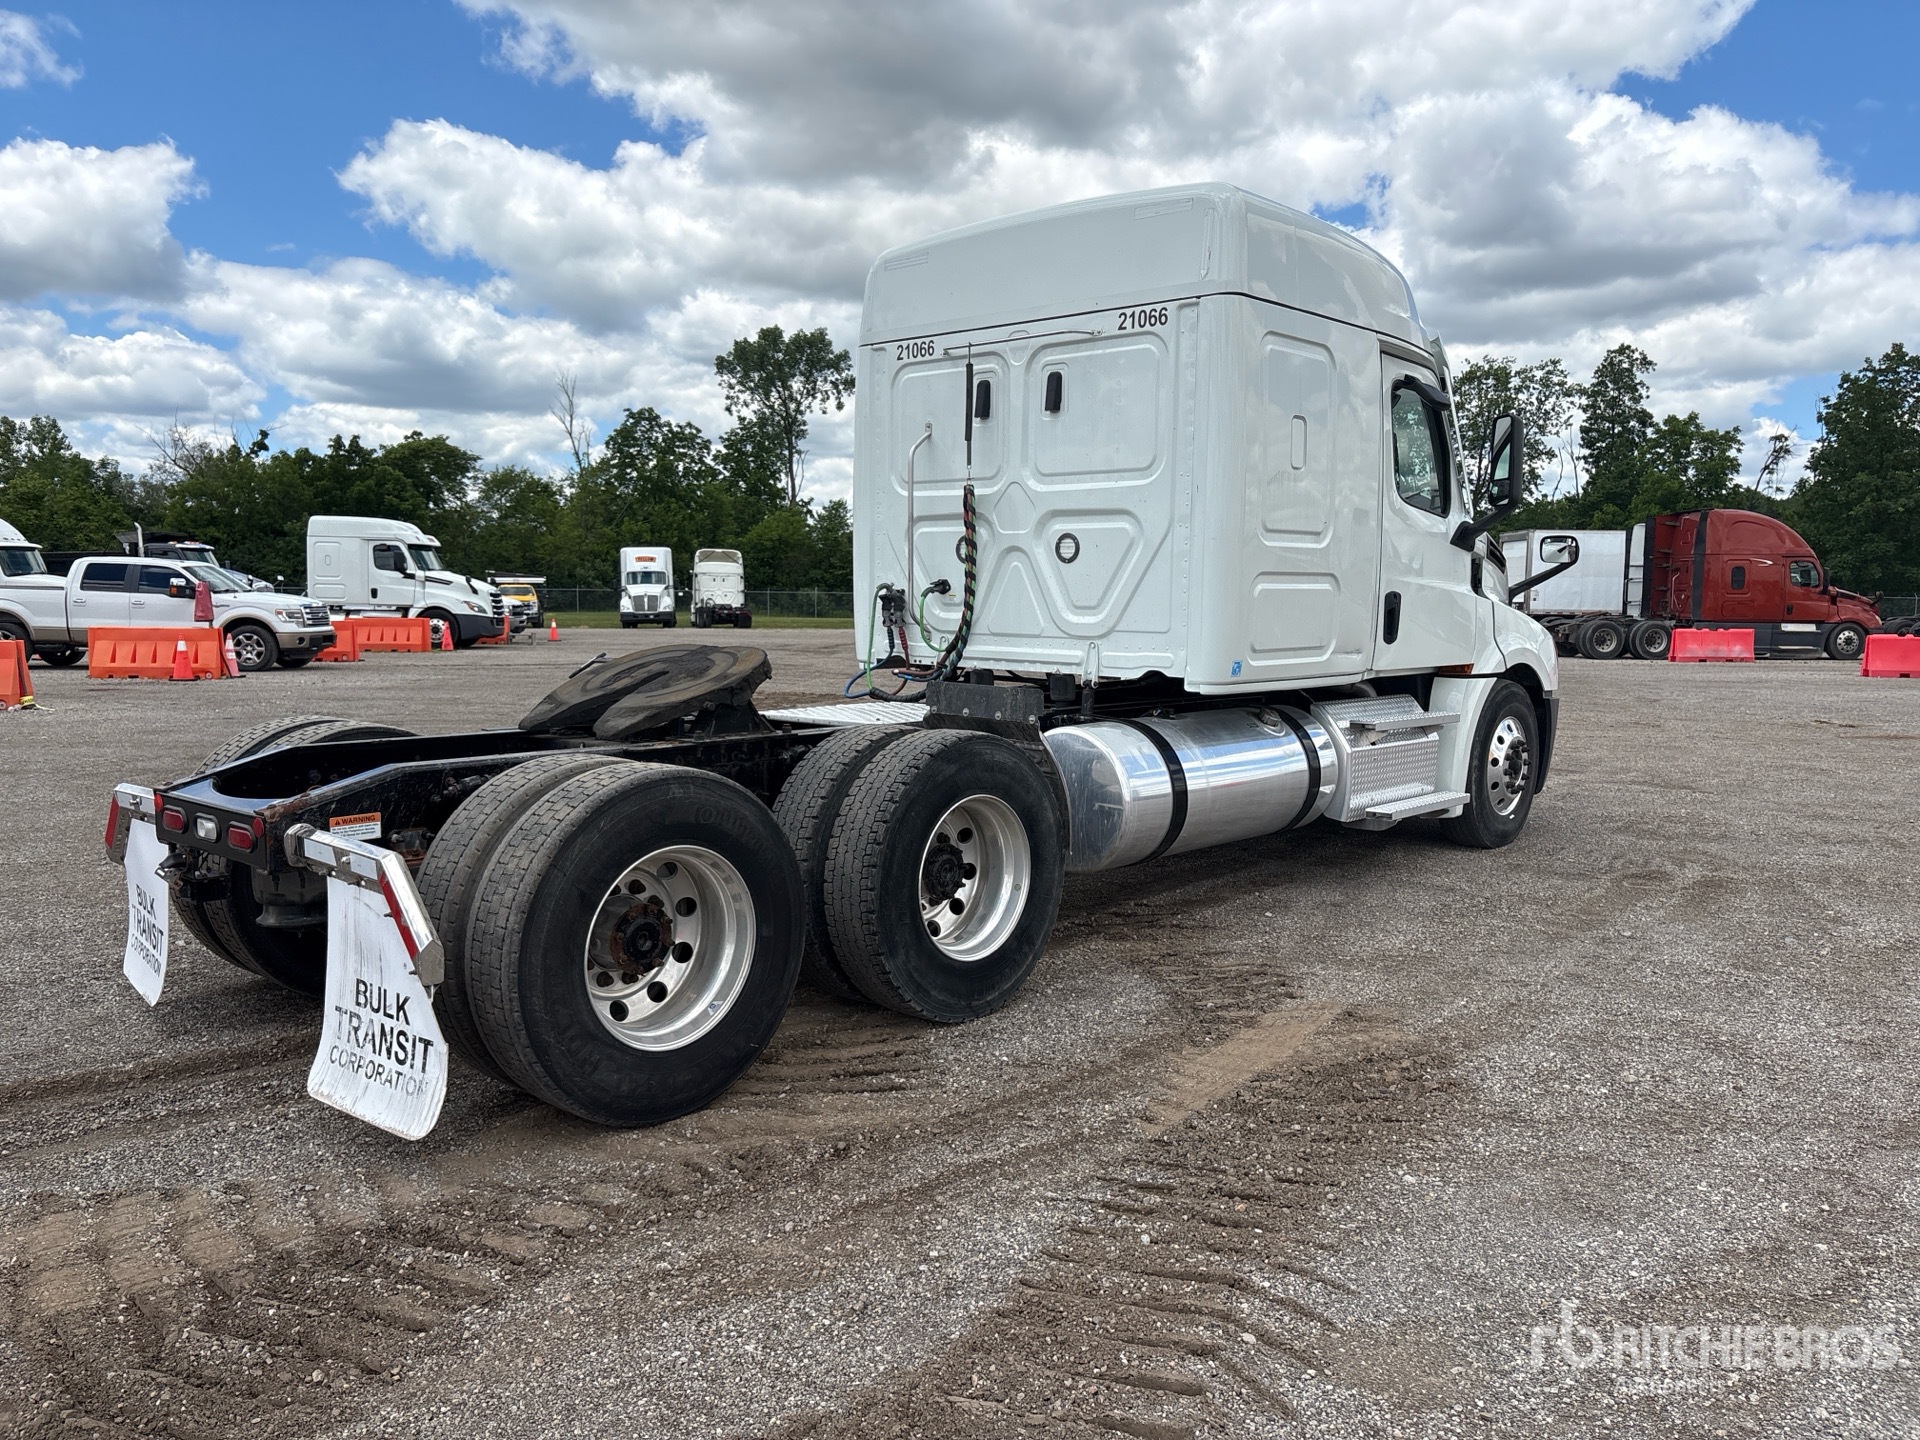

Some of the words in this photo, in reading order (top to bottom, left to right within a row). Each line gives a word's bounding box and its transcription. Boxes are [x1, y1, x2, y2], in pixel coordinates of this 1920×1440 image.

[1117, 308, 1169, 330] 21066
[896, 341, 935, 361] 21066
[342, 815, 376, 824] WARNING
[136, 884, 156, 920] BULK
[132, 904, 164, 956] TRANSIT
[355, 978, 410, 1026] BULK
[335, 1006, 434, 1073] TRANSIT
[330, 1045, 428, 1097] CORPORATION
